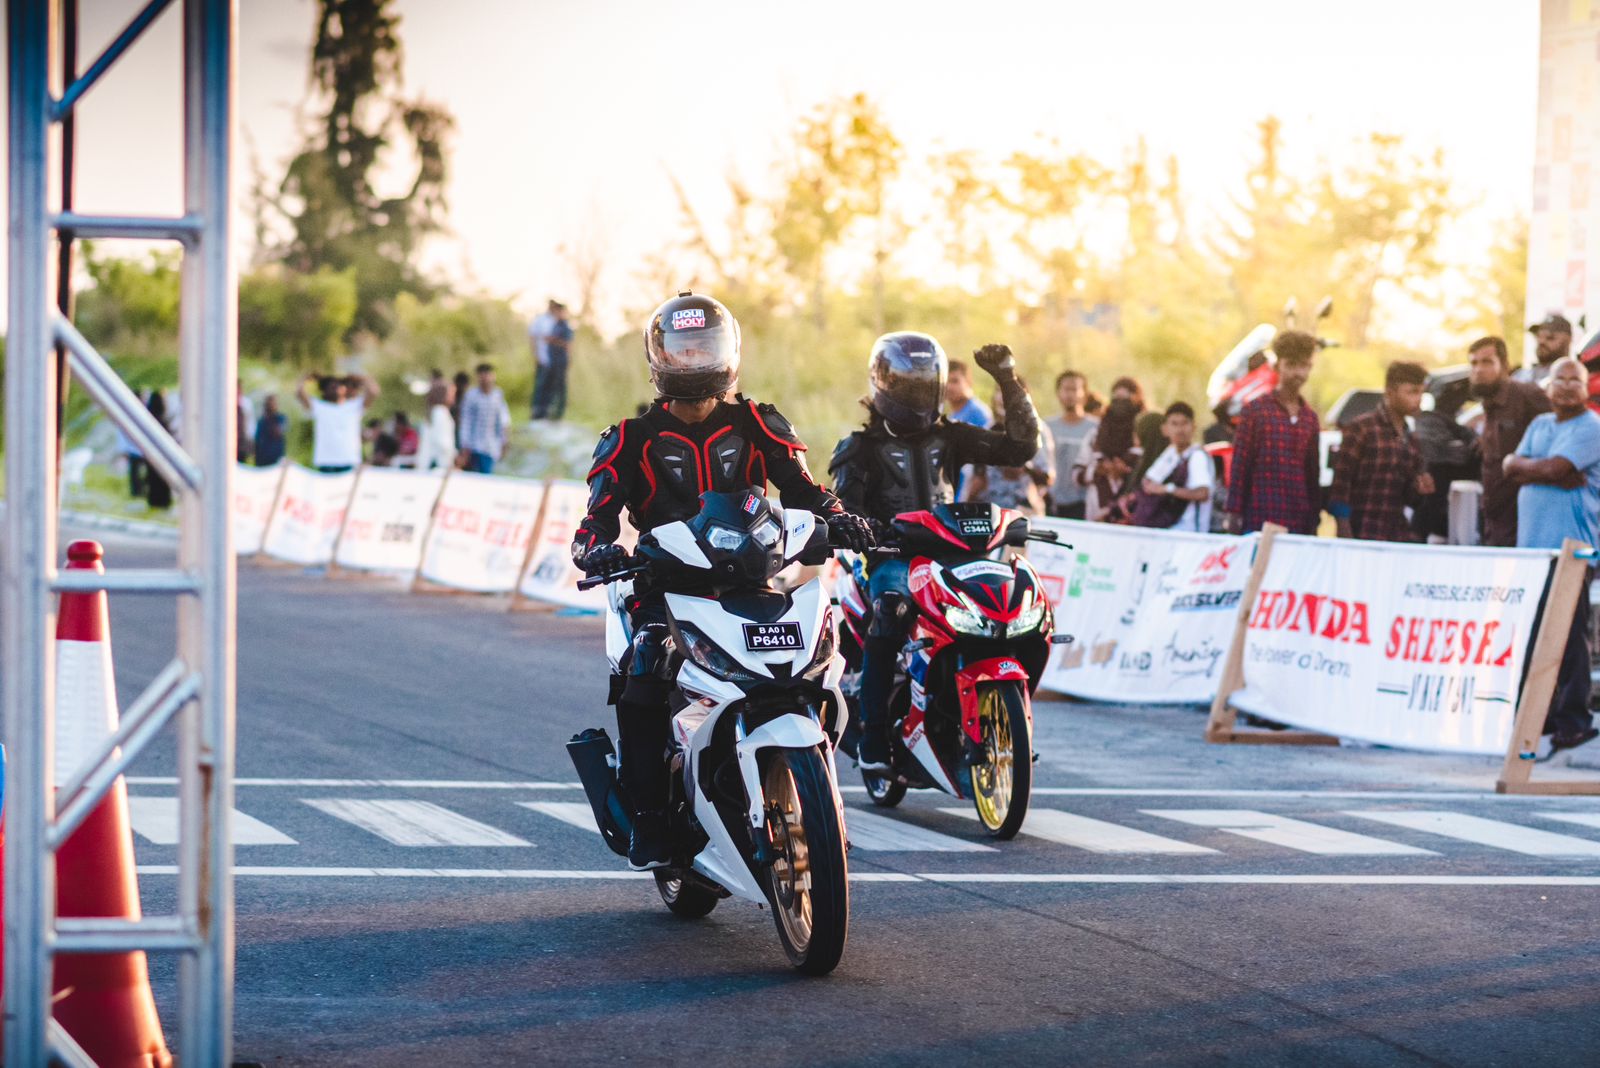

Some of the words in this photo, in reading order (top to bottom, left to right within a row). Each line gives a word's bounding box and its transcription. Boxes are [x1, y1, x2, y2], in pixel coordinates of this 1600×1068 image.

[675, 310, 703, 319] LIQUI
[675, 318, 703, 328] MOLY
[1249, 590, 1371, 645] HONDA
[752, 635, 795, 646] P6410
